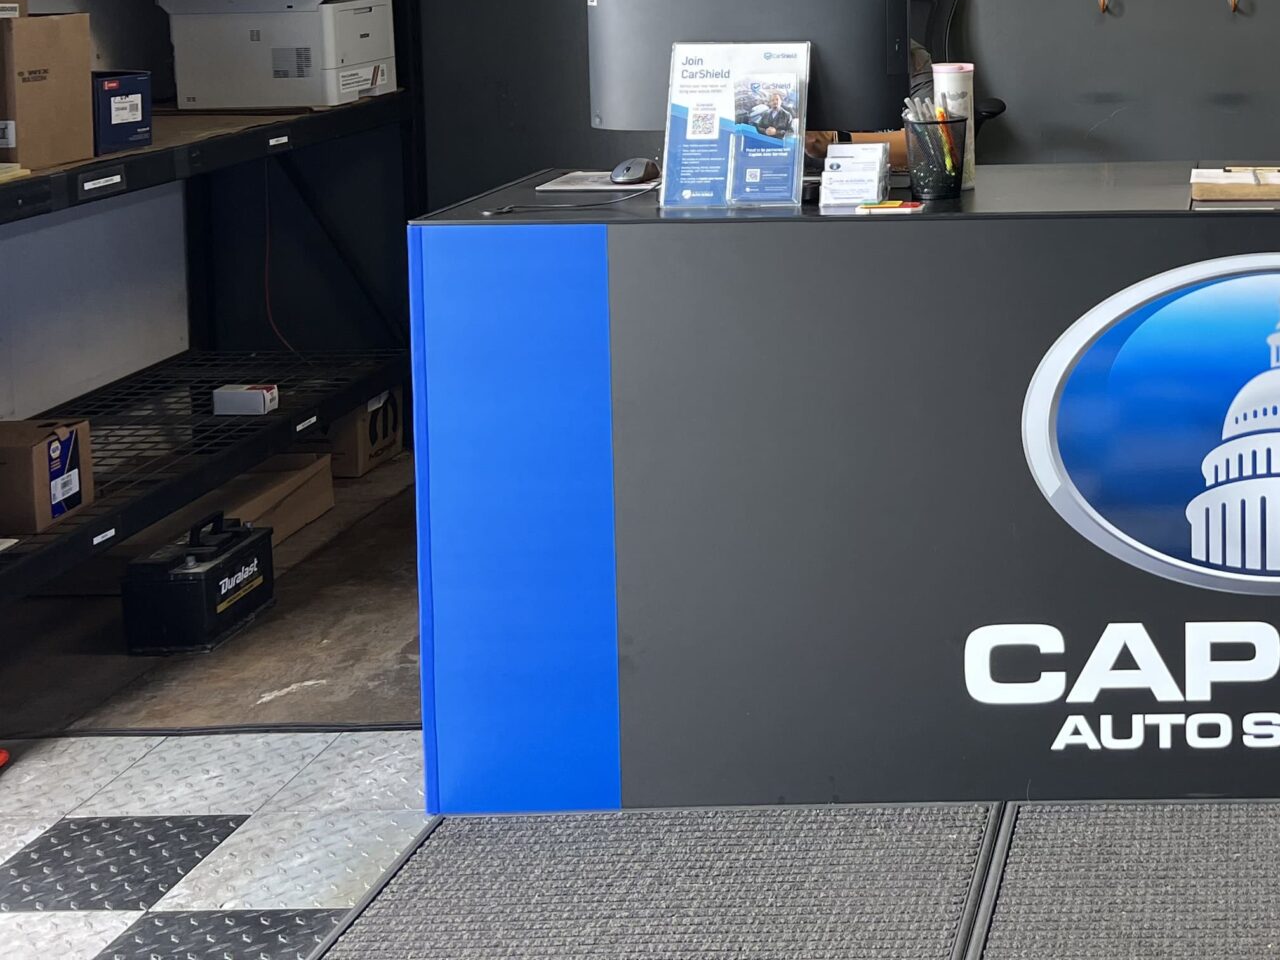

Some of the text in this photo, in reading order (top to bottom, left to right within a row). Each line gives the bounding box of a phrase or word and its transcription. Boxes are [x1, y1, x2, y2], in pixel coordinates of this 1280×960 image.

[682, 56, 703, 65] Join
[681, 70, 730, 79] CarShield
[219, 557, 258, 595] Duralast
[1050, 712, 1233, 751] AUTO
